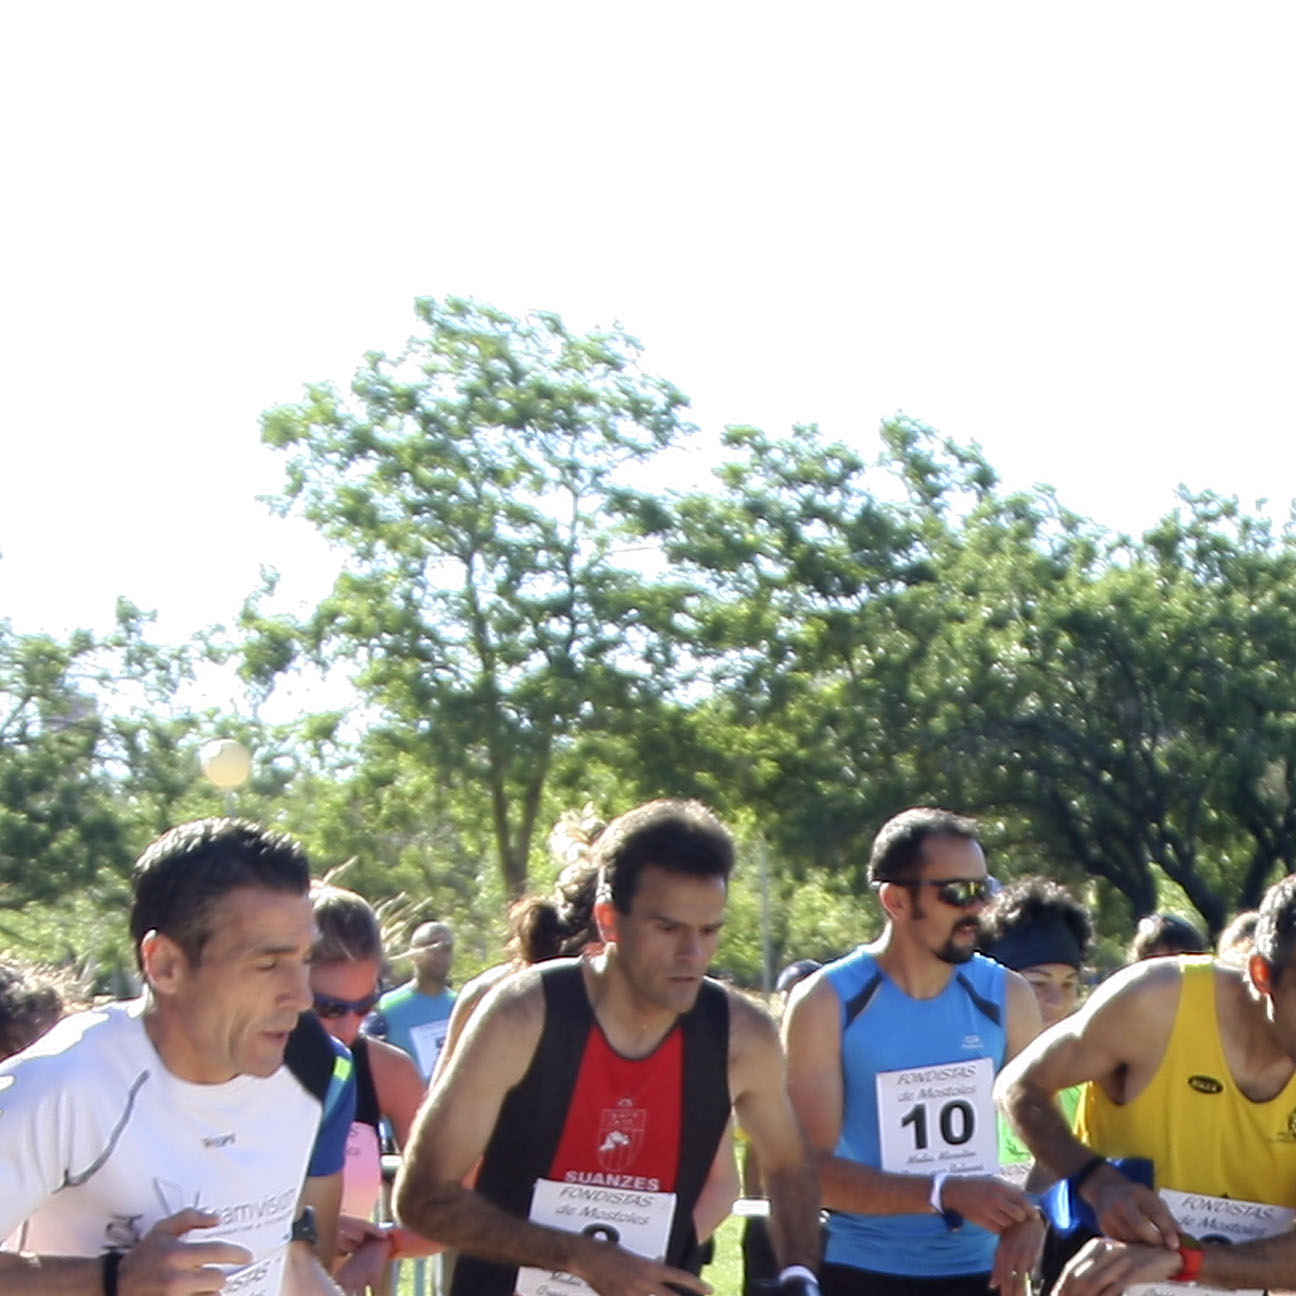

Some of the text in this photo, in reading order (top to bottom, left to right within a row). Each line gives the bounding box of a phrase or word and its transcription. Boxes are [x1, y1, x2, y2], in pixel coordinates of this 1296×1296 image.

[898, 1065, 977, 1085] FONDISTAS
[901, 1099, 975, 1150] 10
[565, 1171, 660, 1192] SUANZES
[560, 1186, 654, 1208] FONDISTAS
[1181, 1196, 1275, 1219] FONDISTAS
[555, 1203, 575, 1216] de
